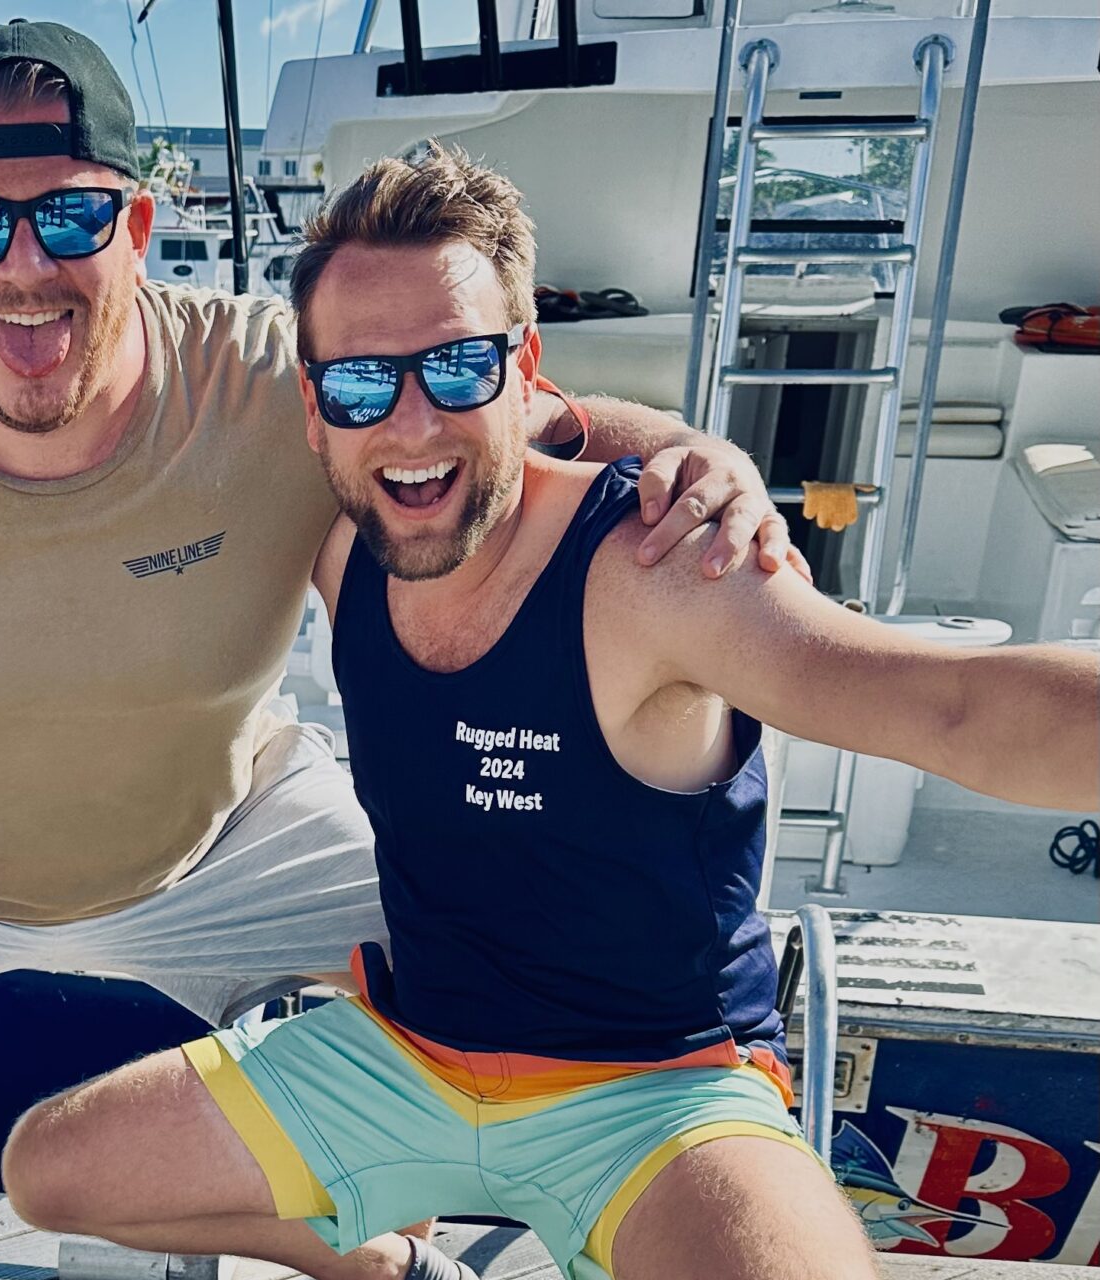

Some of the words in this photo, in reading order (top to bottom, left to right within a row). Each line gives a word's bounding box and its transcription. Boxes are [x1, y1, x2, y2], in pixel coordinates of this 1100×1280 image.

[149, 549, 177, 570] NINE
[177, 543, 204, 563] LINE
[455, 720, 517, 752] Rugged
[519, 729, 561, 752] Heat
[480, 756, 525, 780] 2024
[466, 783, 494, 812] Key
[496, 789, 543, 811] West
